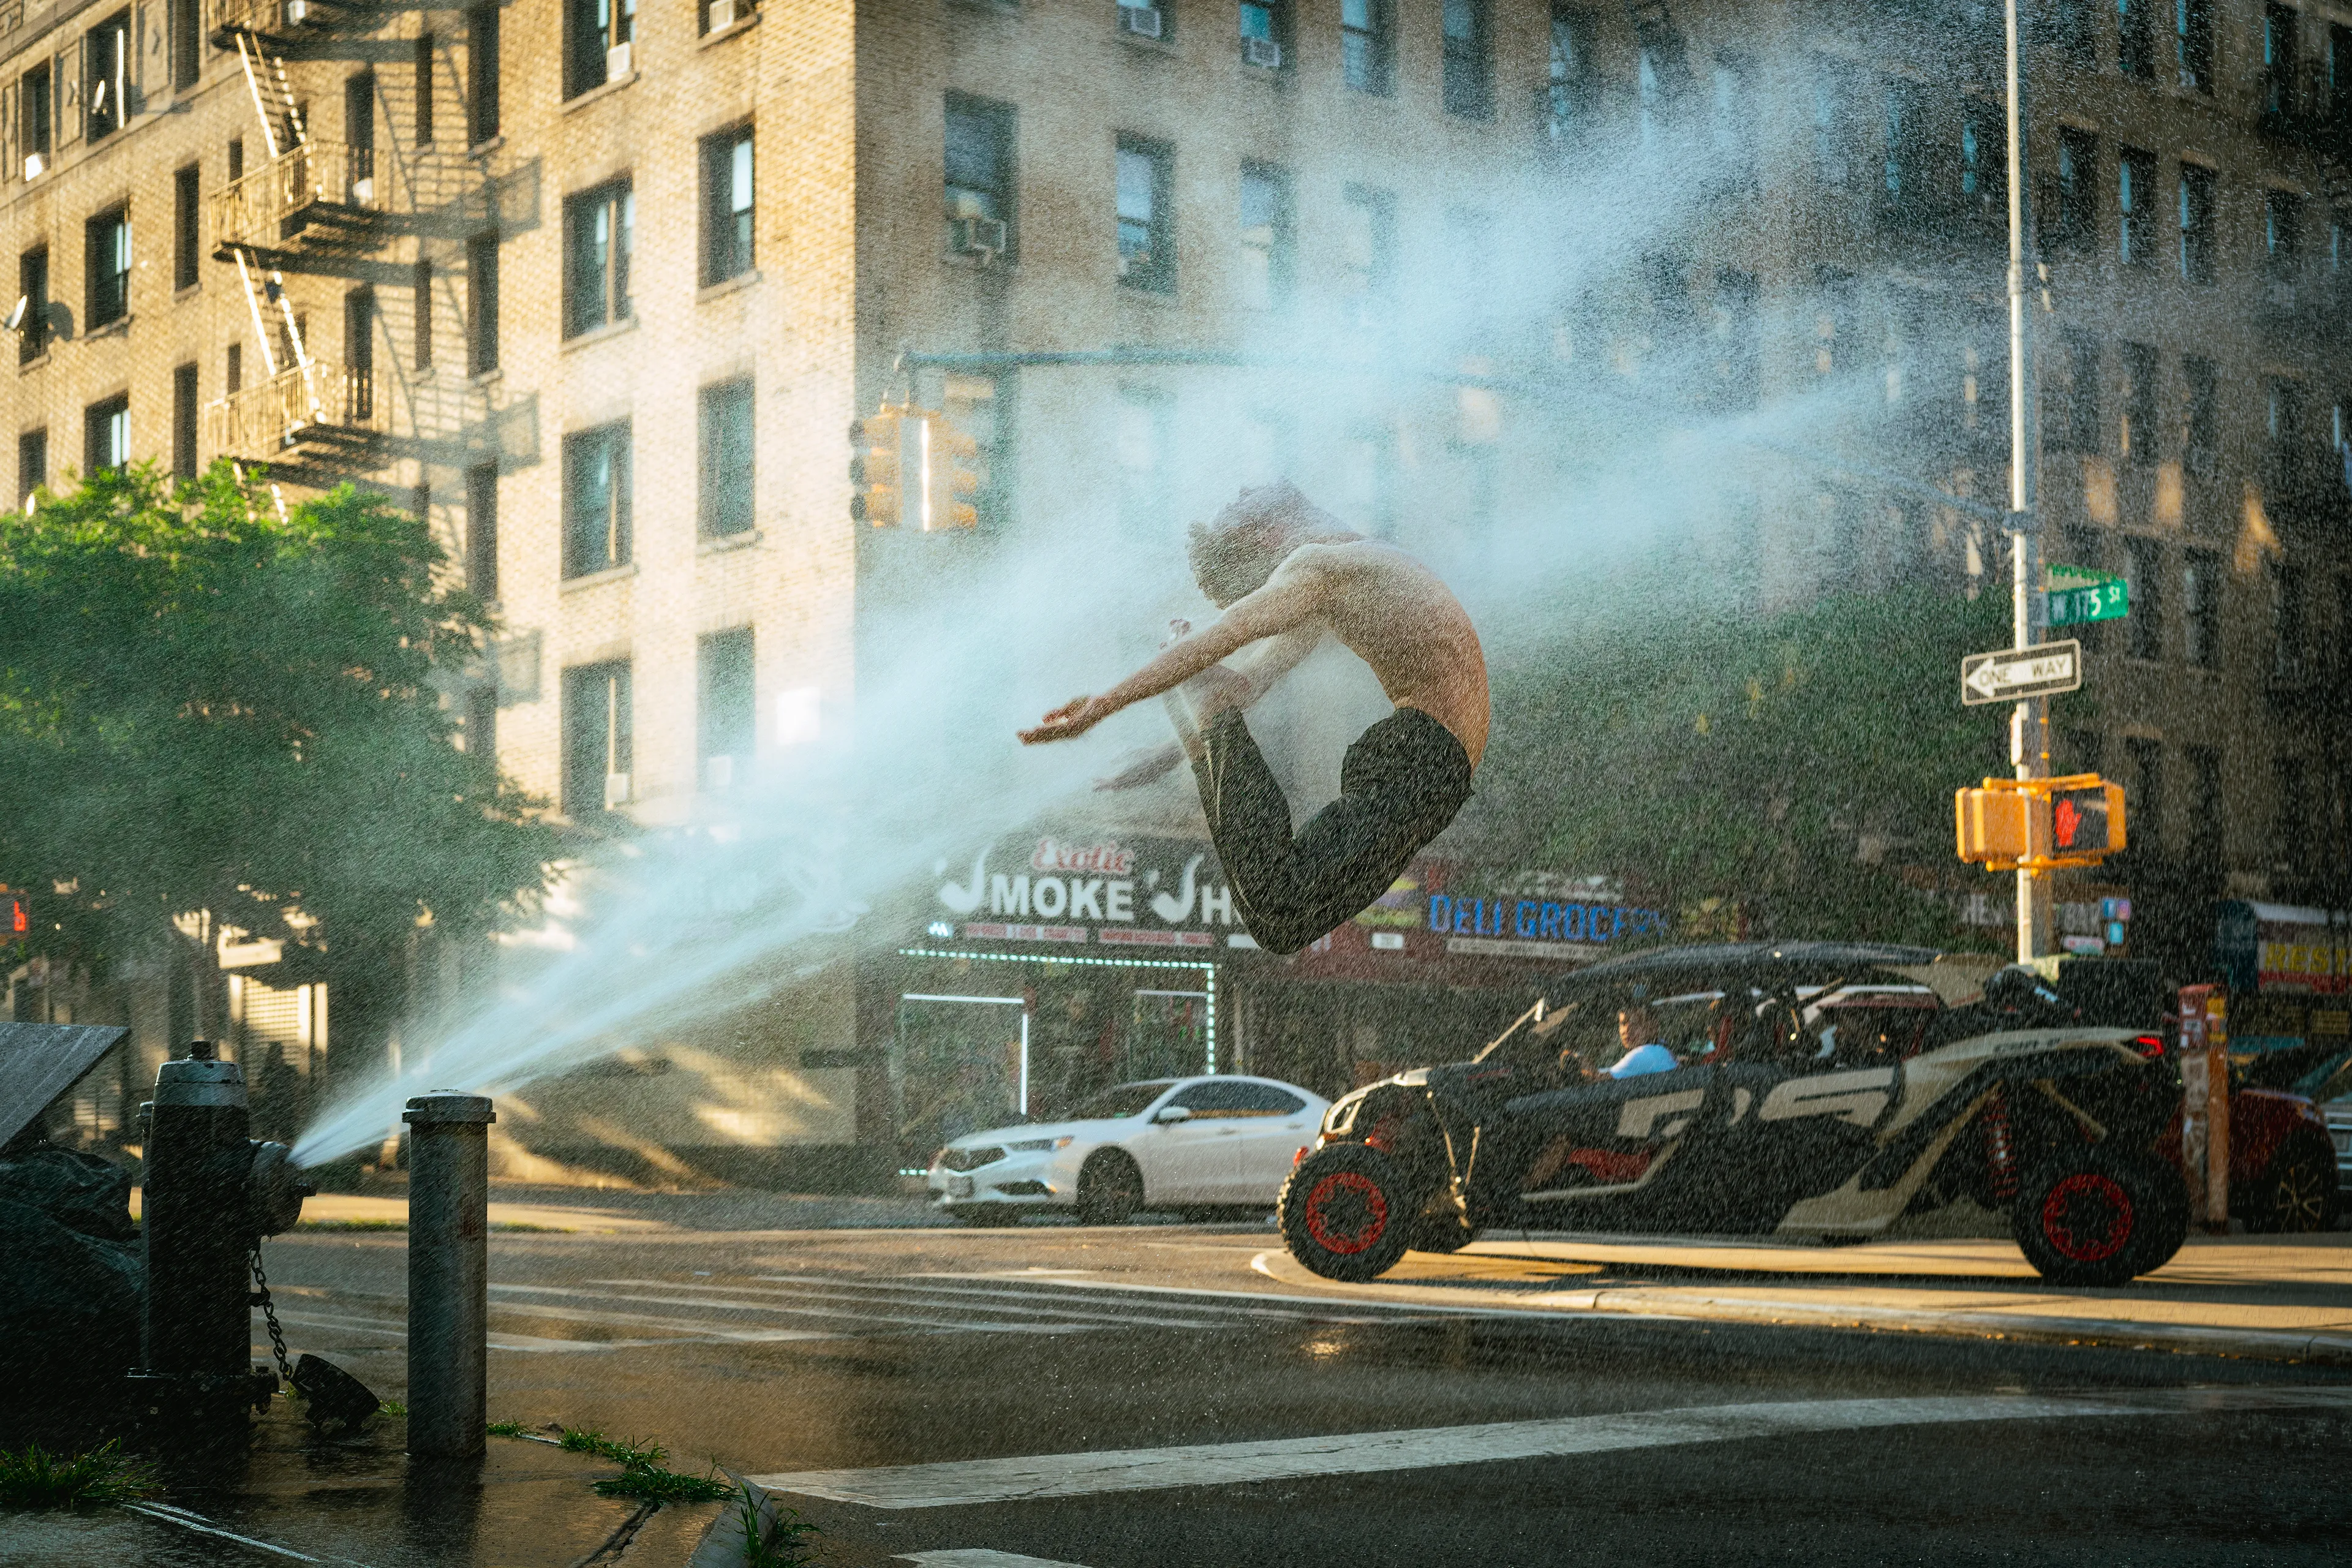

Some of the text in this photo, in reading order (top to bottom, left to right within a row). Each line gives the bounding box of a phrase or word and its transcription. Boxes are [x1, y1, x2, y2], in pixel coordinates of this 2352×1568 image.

[1979, 658, 2067, 687] ONE WAY
[1031, 837, 1134, 875] Exotic
[1430, 894, 1503, 935] DELI
